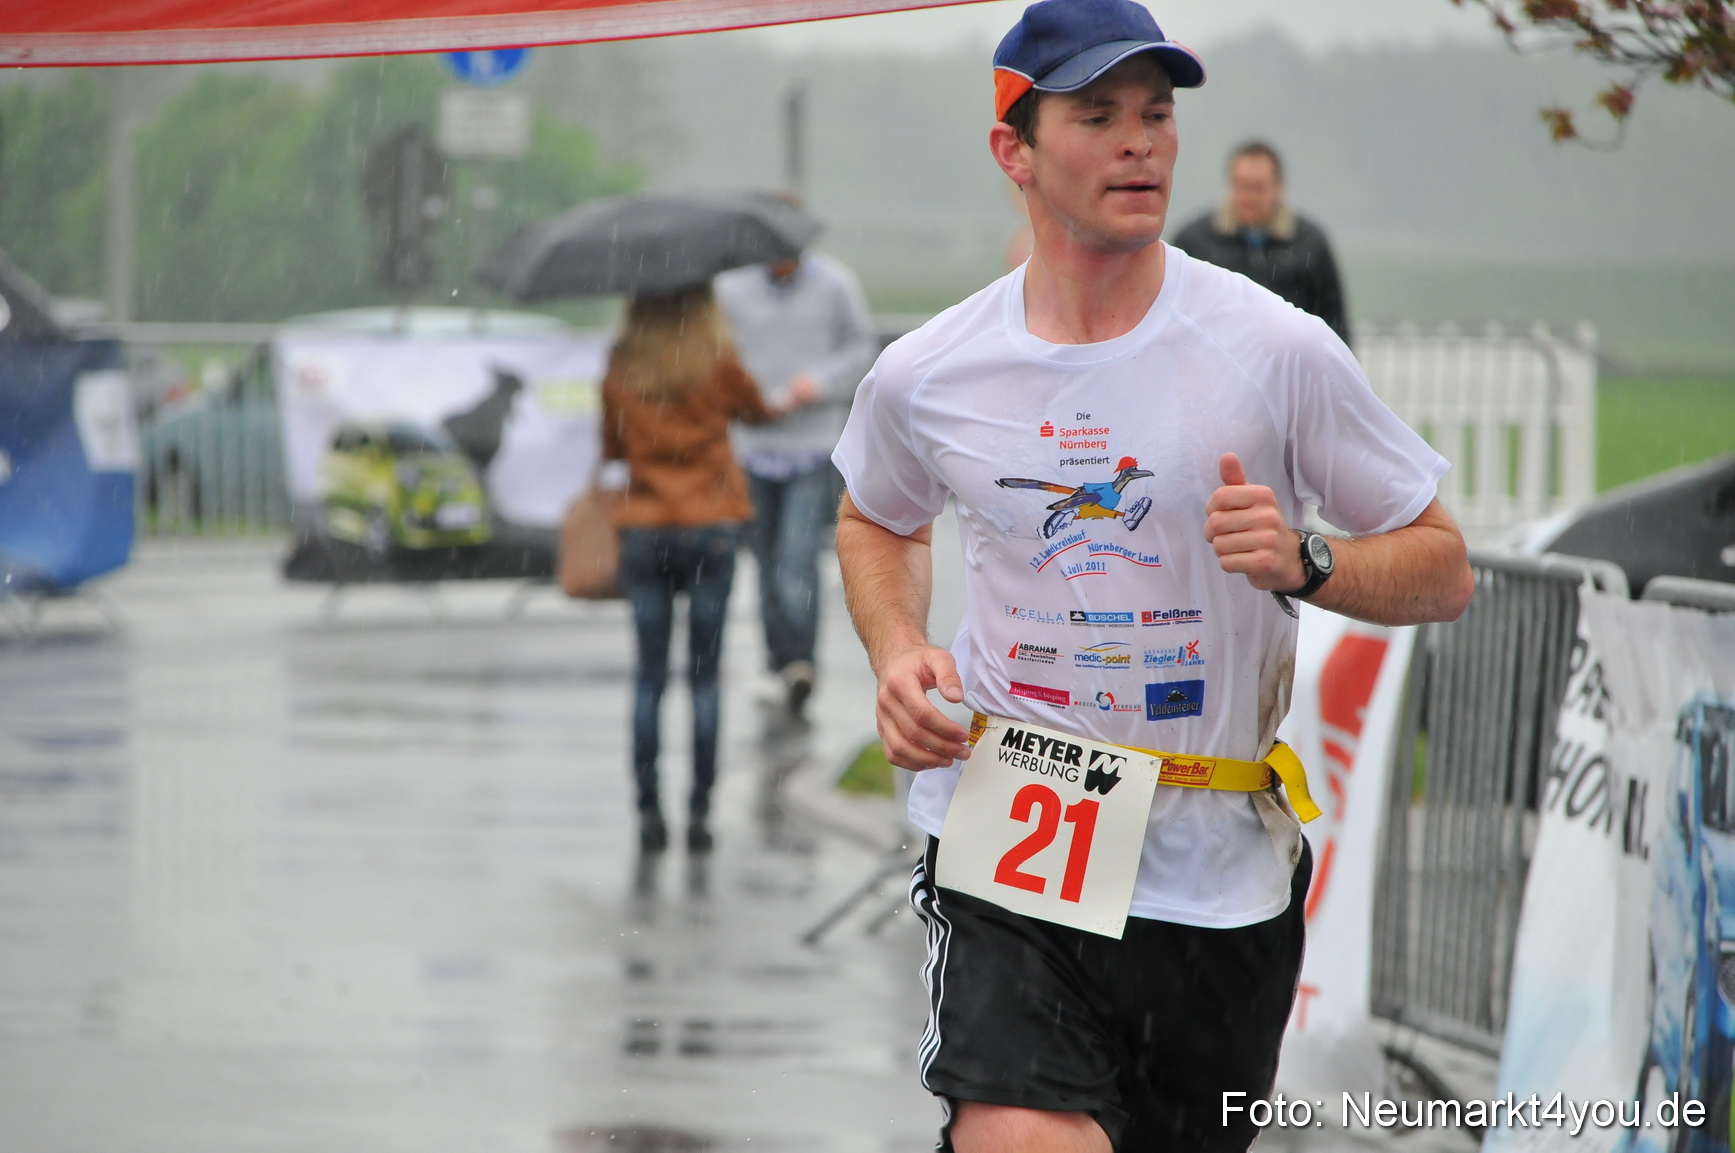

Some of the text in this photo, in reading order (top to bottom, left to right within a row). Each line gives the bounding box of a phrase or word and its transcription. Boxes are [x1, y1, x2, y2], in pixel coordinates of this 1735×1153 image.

[1076, 412, 1091, 421] Die
[1059, 427, 1110, 438] Sparkasse
[1059, 440, 1107, 450] Nürnberg
[1060, 456, 1110, 467] präsentiert
[1039, 530, 1086, 559] Landkreislauf
[1087, 543, 1137, 559] Nürnberger
[1138, 552, 1160, 564] Land
[1067, 563, 1083, 575] Juli
[1085, 562, 1106, 571] 2011
[1152, 608, 1203, 620] Felßner
[1018, 643, 1058, 655] ABRAHAM
[1074, 653, 1131, 666] medic-point
[1144, 654, 1177, 665] Ziegler
[1000, 727, 1083, 767] MEYER
[998, 747, 1080, 783] WERBUNG
[1160, 758, 1210, 775] PowerBar
[993, 783, 1100, 904] 21
